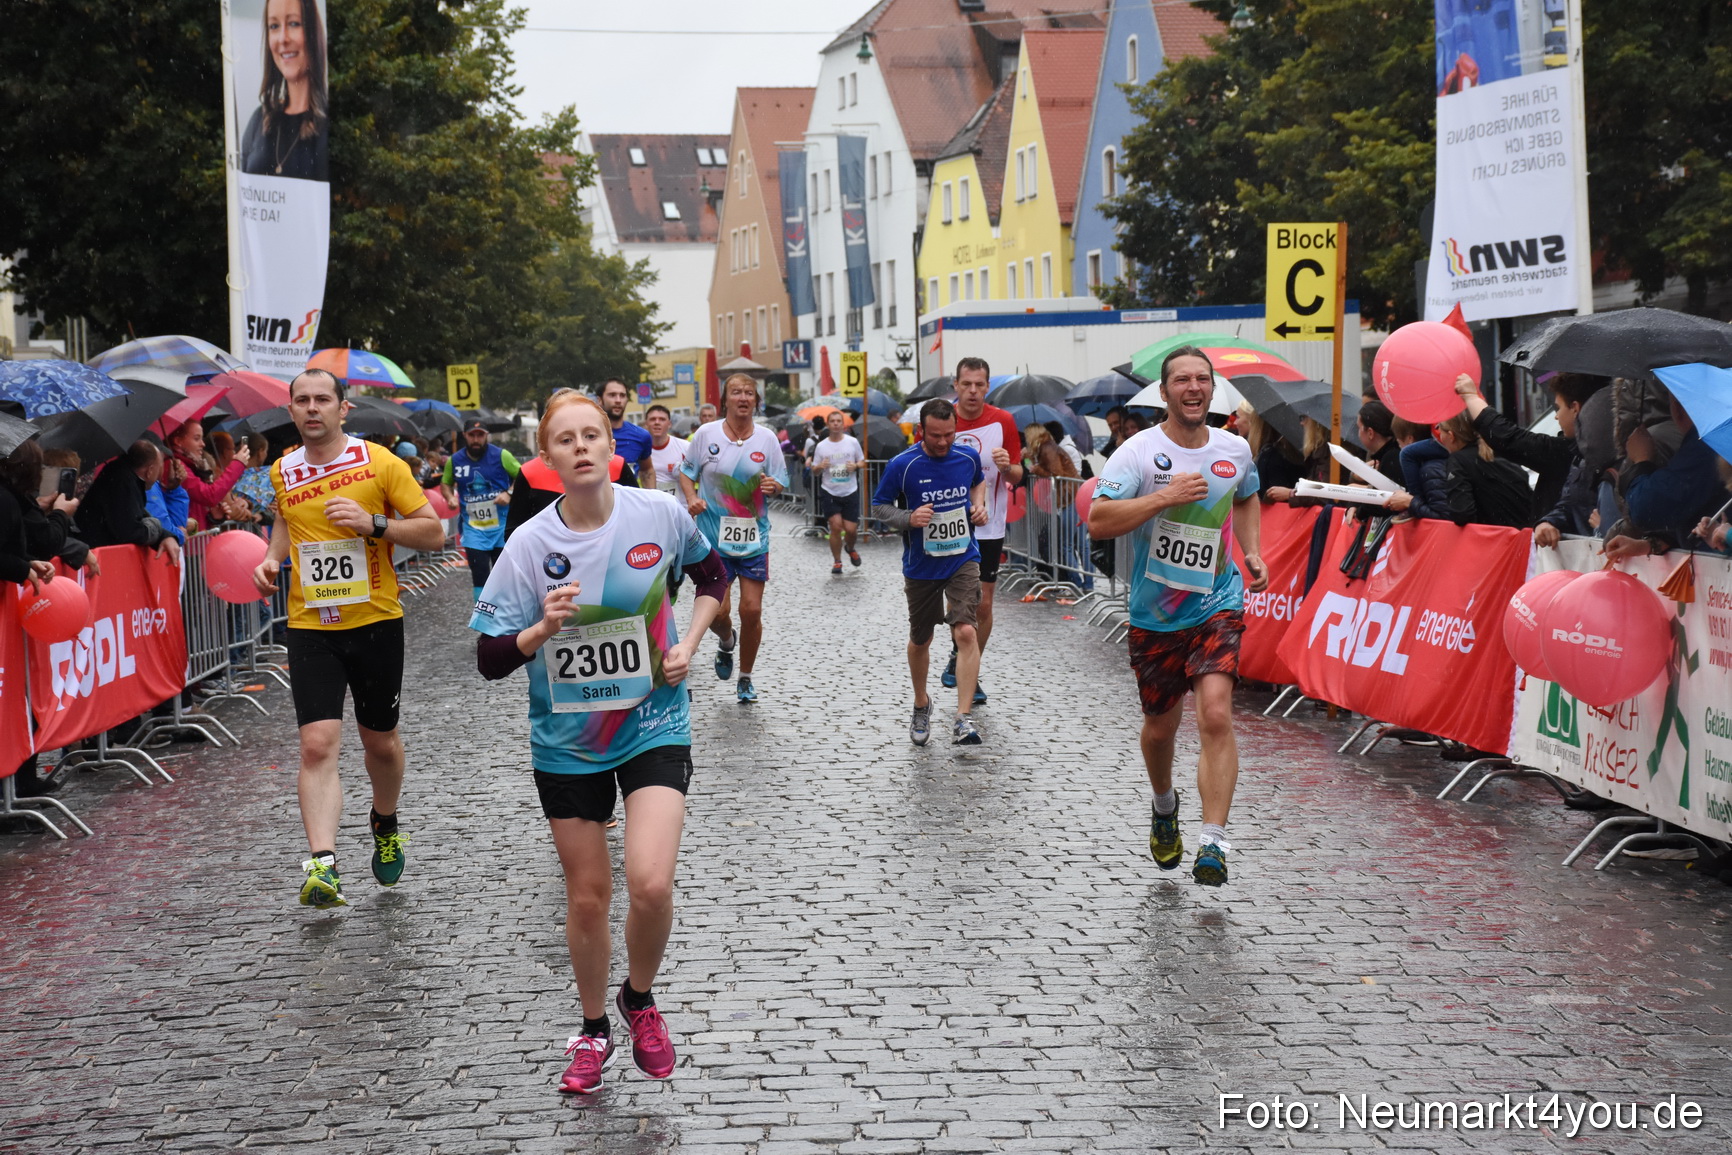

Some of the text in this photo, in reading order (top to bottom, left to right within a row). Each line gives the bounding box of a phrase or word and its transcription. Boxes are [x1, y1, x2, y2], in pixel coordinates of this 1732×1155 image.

[1277, 228, 1337, 249] Block
[1285, 258, 1325, 317] C
[246, 314, 292, 343] swn
[842, 352, 864, 362] Block
[451, 366, 474, 376] Block
[847, 365, 861, 387] D
[456, 379, 472, 400] D
[454, 465, 470, 478] 21
[286, 468, 376, 508] MAX BÖGL
[921, 486, 968, 503] SYSCAD
[472, 508, 492, 520] 194
[724, 526, 756, 542] 2616
[928, 519, 966, 539] 2906
[1184, 527, 1217, 540] BOCK
[936, 541, 961, 552] Thomas
[1156, 535, 1214, 569] 3059
[630, 549, 659, 564] Hervis
[310, 555, 354, 582] 326
[315, 587, 352, 598] Scherer
[587, 620, 637, 637] BOCK
[1414, 598, 1476, 654] energie
[555, 639, 641, 680] 2300
[1584, 647, 1622, 659] energie
[582, 683, 621, 699] Sarah
